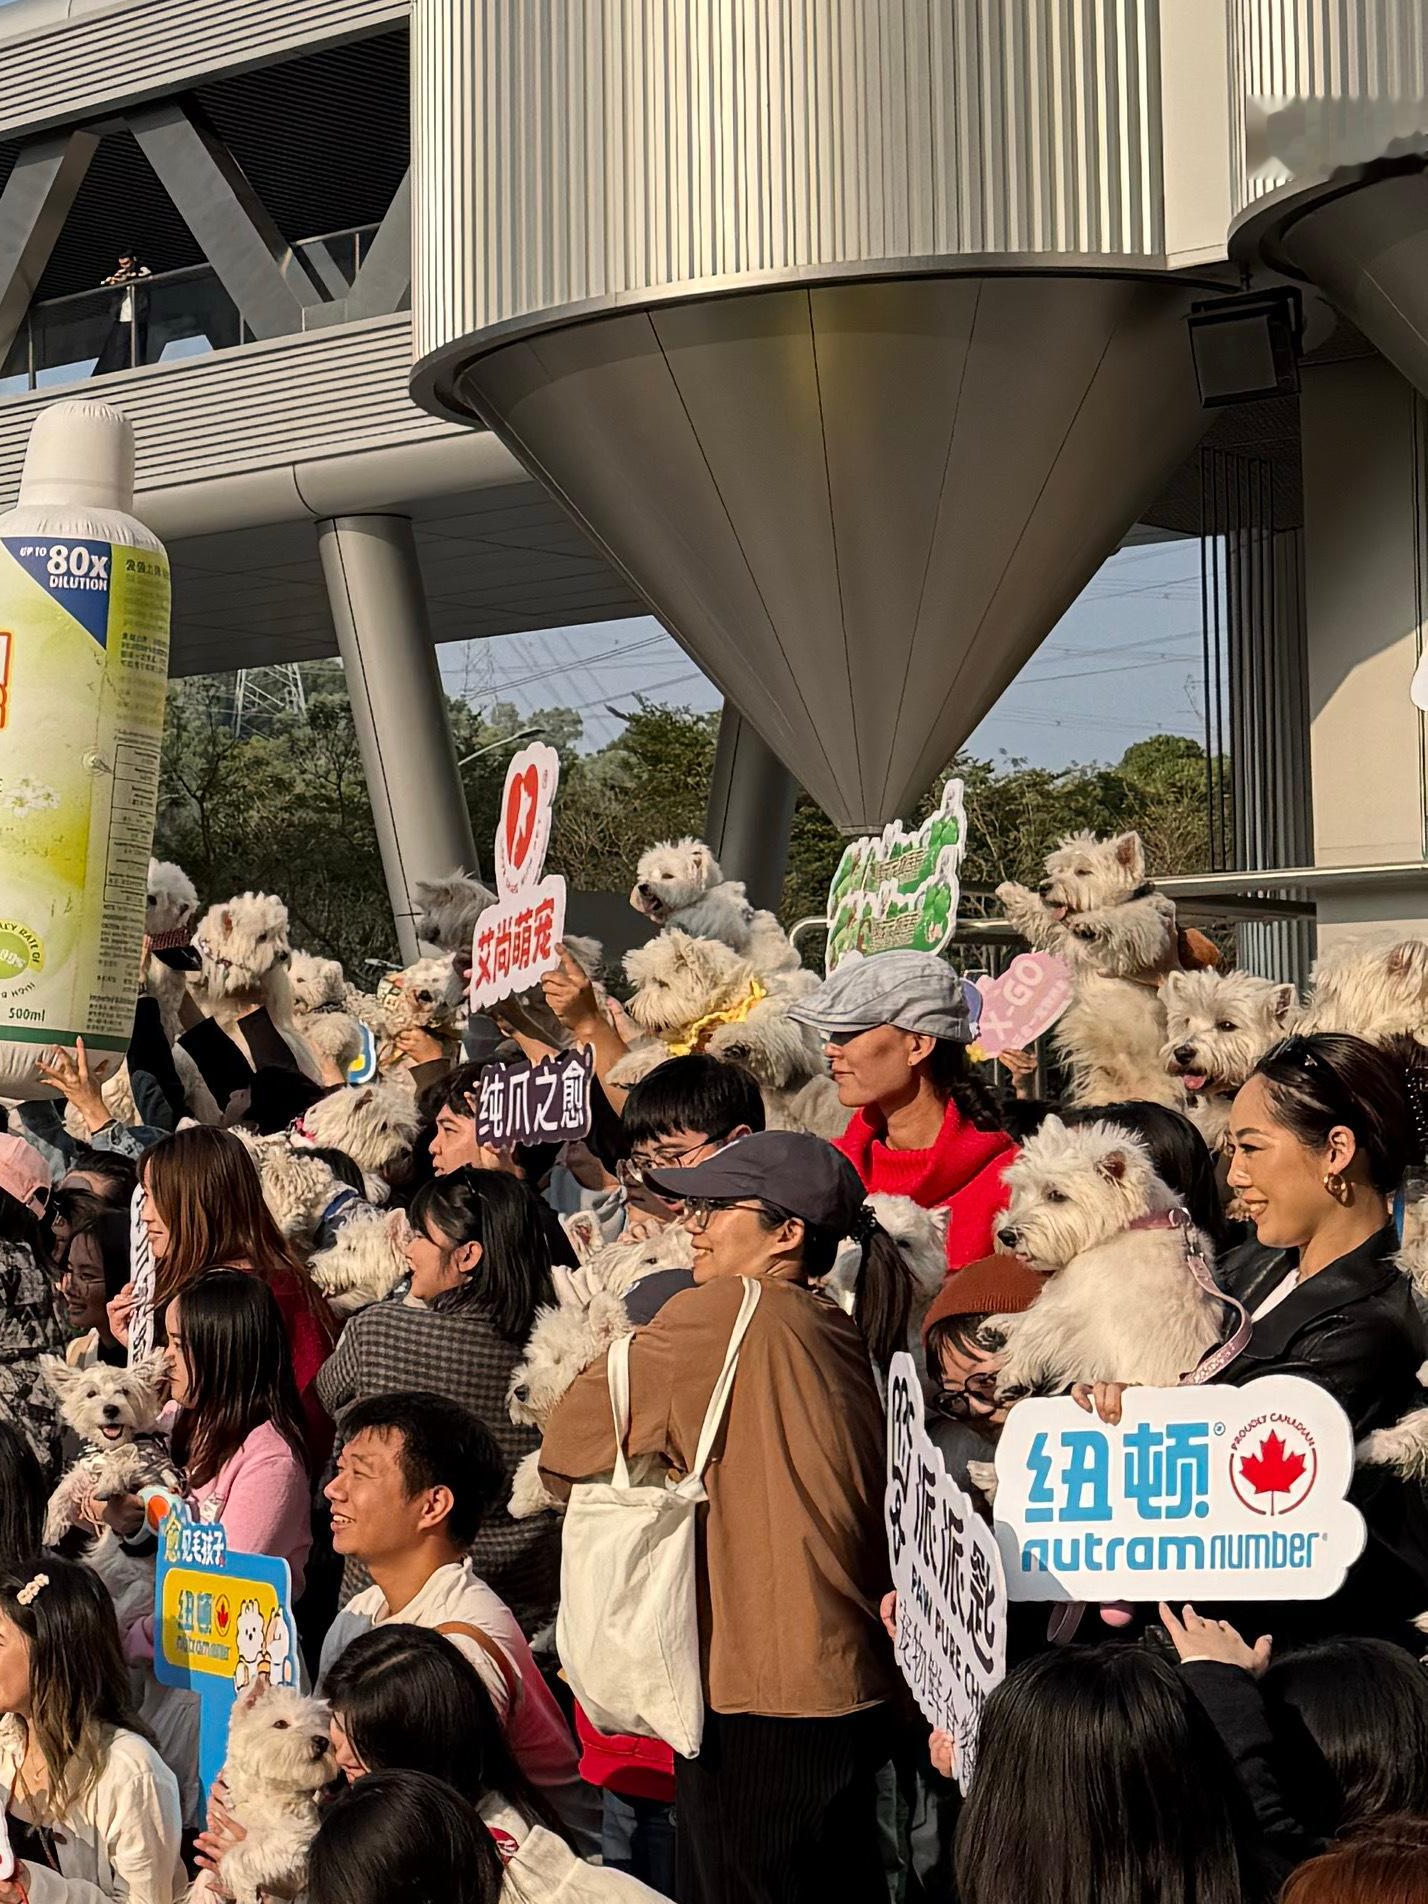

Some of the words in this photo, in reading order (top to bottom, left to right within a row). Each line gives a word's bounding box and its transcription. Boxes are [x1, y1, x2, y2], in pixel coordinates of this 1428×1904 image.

[49, 575, 108, 591] DILUTION
[475, 897, 555, 990] 艾尚萌宠
[8, 1007, 45, 1022] 500ml
[478, 1060, 586, 1137] 纯爪之愈
[1024, 1422, 1210, 1523] 纽顿
